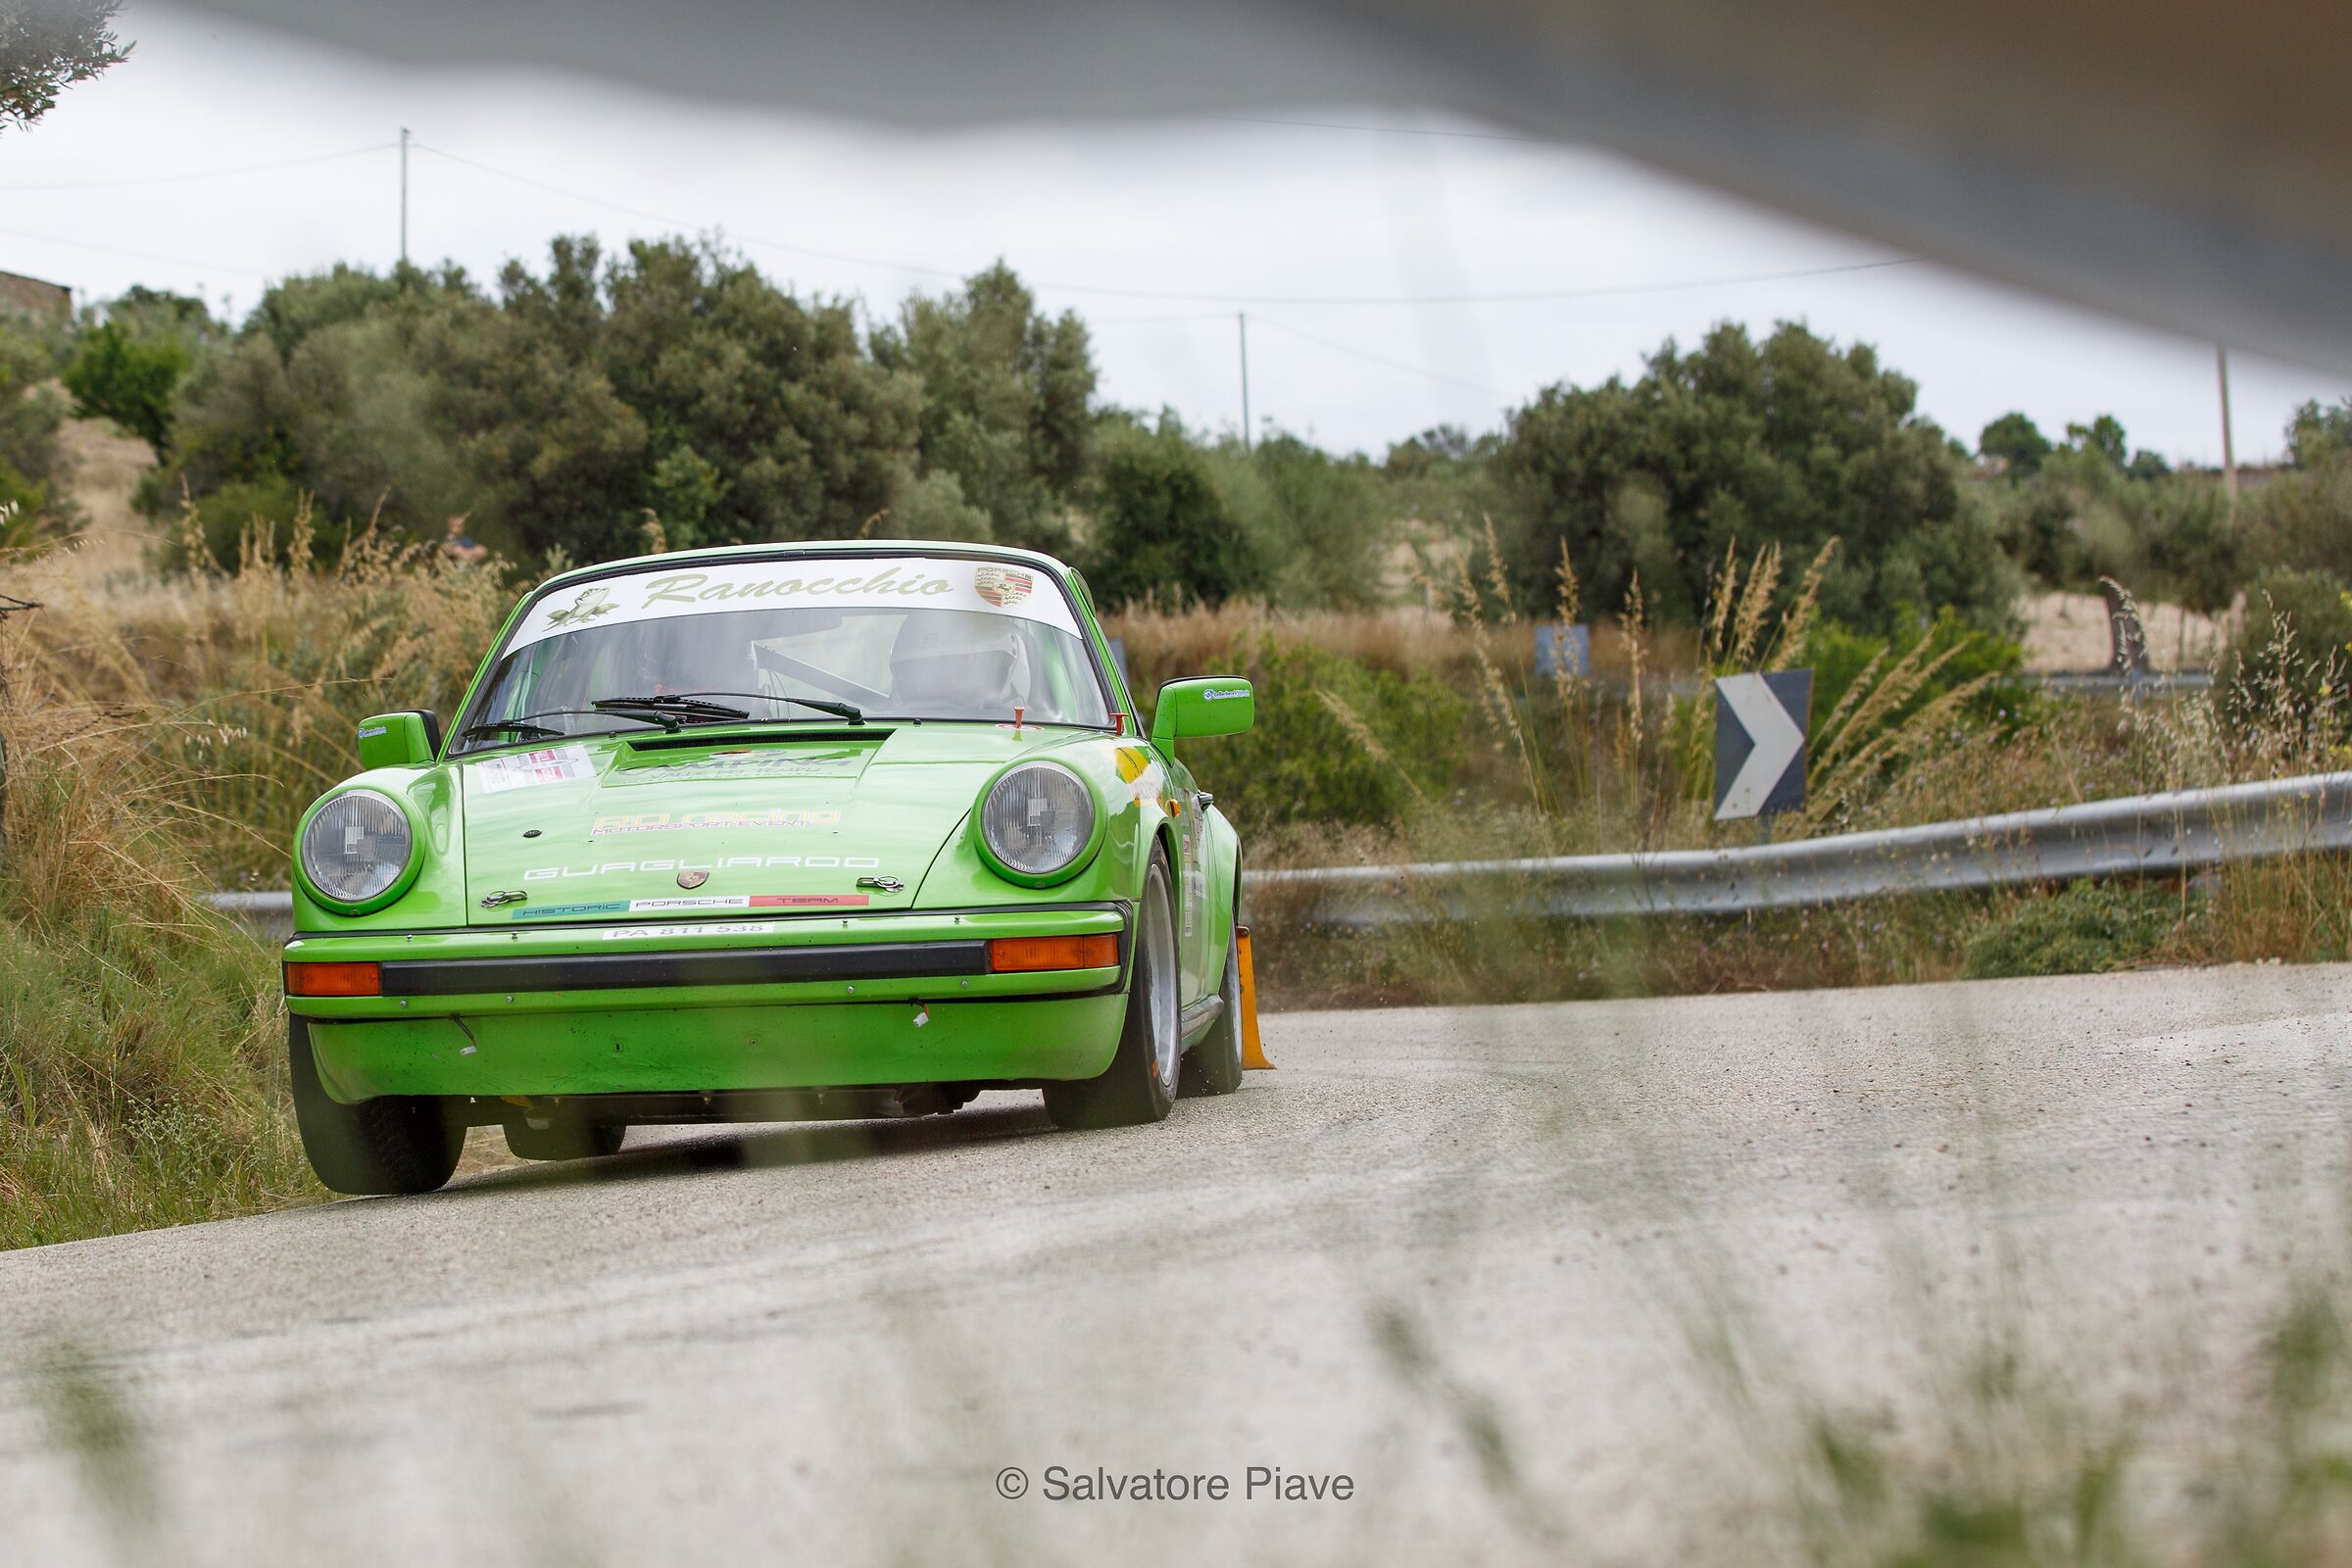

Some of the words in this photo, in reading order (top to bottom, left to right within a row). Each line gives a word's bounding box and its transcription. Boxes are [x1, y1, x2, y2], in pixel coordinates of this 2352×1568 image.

[641, 566, 954, 610] Ranocchio
[522, 856, 880, 881] GUAGLIARDO
[522, 903, 621, 916] HISTORIC
[635, 898, 745, 907] PORSCHE
[612, 929, 649, 938] PA
[660, 926, 704, 936] 811
[716, 924, 764, 934] 538
